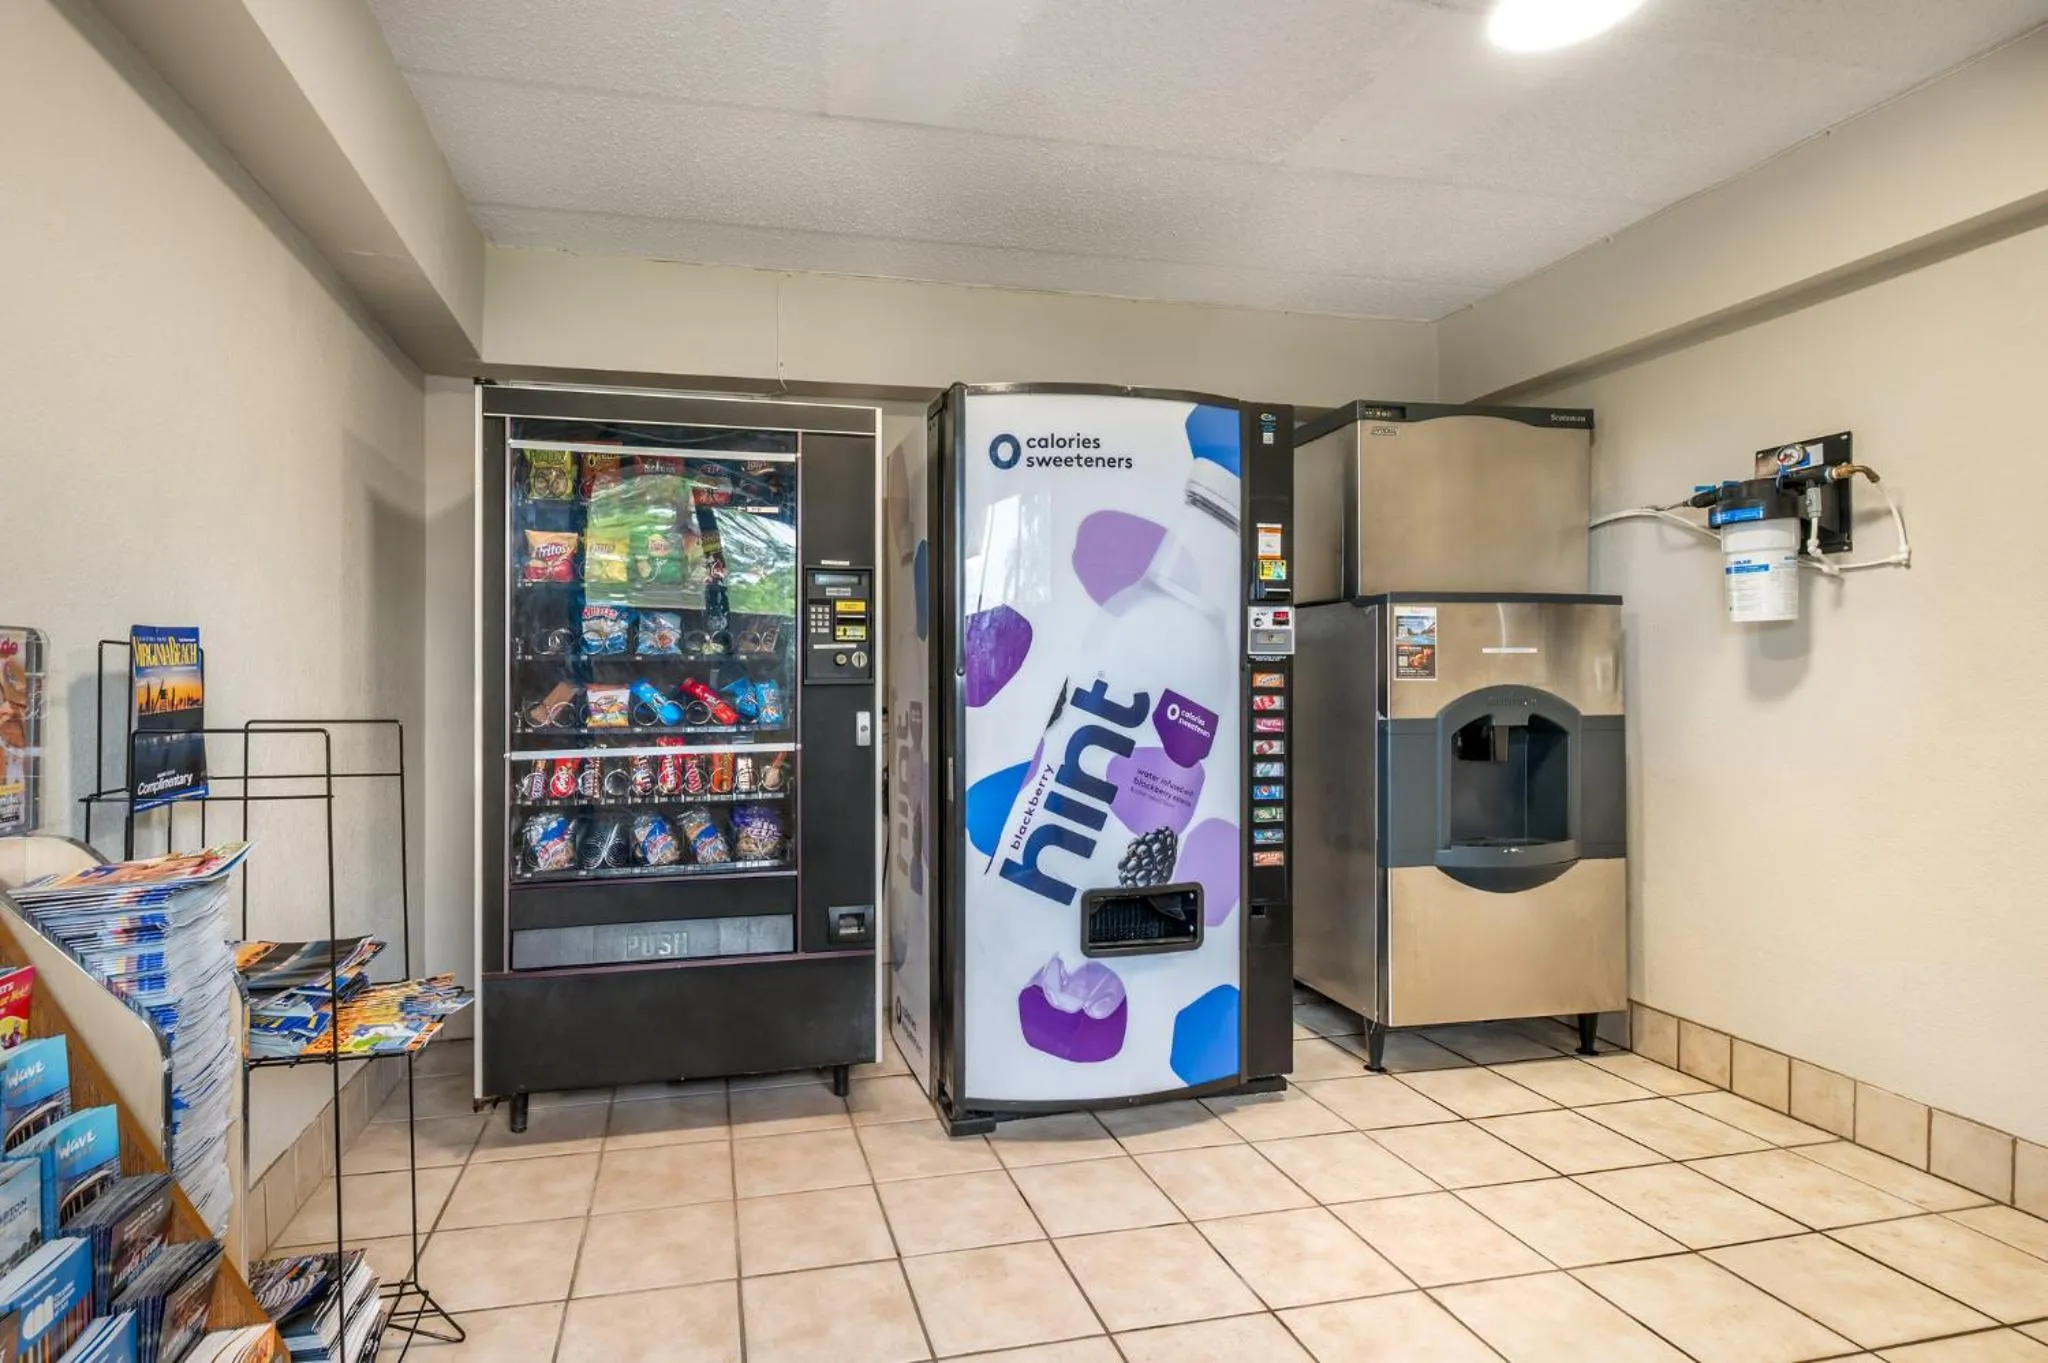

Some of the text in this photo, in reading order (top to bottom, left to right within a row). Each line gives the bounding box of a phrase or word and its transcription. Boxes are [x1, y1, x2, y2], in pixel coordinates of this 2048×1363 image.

[1026, 433, 1101, 449] calories
[1026, 453, 1133, 469] sweeteners
[533, 543, 568, 557] Fritos
[1181, 710, 1206, 726] calories
[137, 772, 194, 796] Complimentary
[1137, 768, 1160, 781] water
[1000, 679, 1150, 906] hint
[1133, 777, 1172, 799] blackberry
[1010, 763, 1055, 850] blackberry
[625, 931, 688, 957] PUSH
